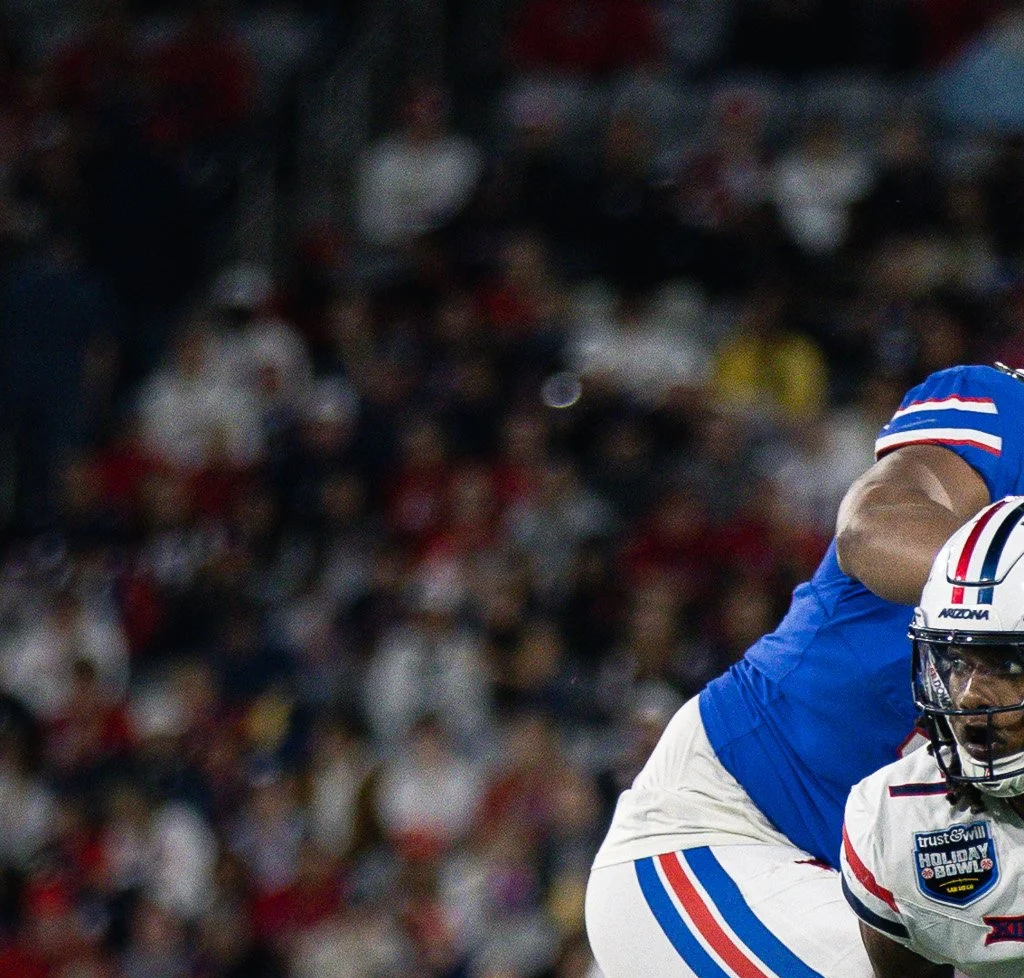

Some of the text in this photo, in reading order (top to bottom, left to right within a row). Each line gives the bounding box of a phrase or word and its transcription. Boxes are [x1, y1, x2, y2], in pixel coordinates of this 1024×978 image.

[938, 608, 989, 620] ARIZONA
[918, 825, 986, 848] trust&will
[918, 842, 989, 868] HOLIDAY
[933, 858, 984, 879] BOWL
